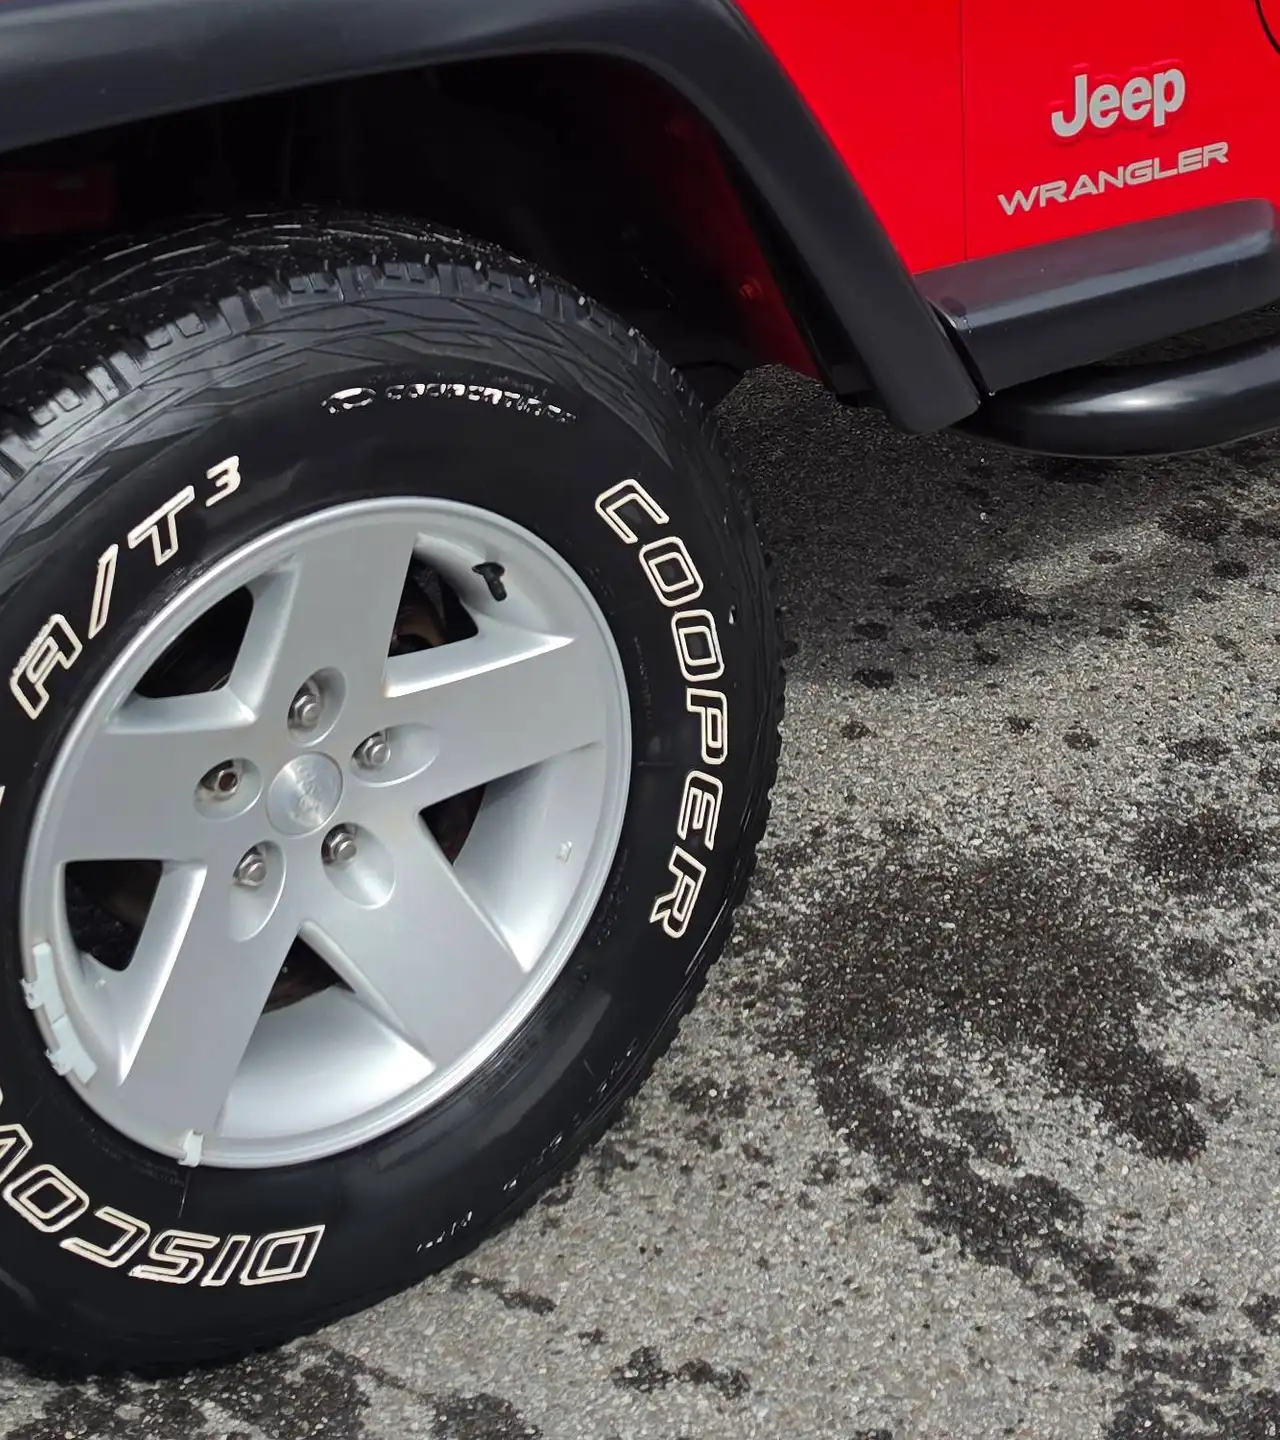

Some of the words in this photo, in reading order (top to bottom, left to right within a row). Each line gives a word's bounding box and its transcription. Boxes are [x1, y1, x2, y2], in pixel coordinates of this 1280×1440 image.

[1050, 67, 1187, 139] Jeep
[996, 141, 1229, 217] WRANGLER
[594, 477, 729, 941] COOPER
